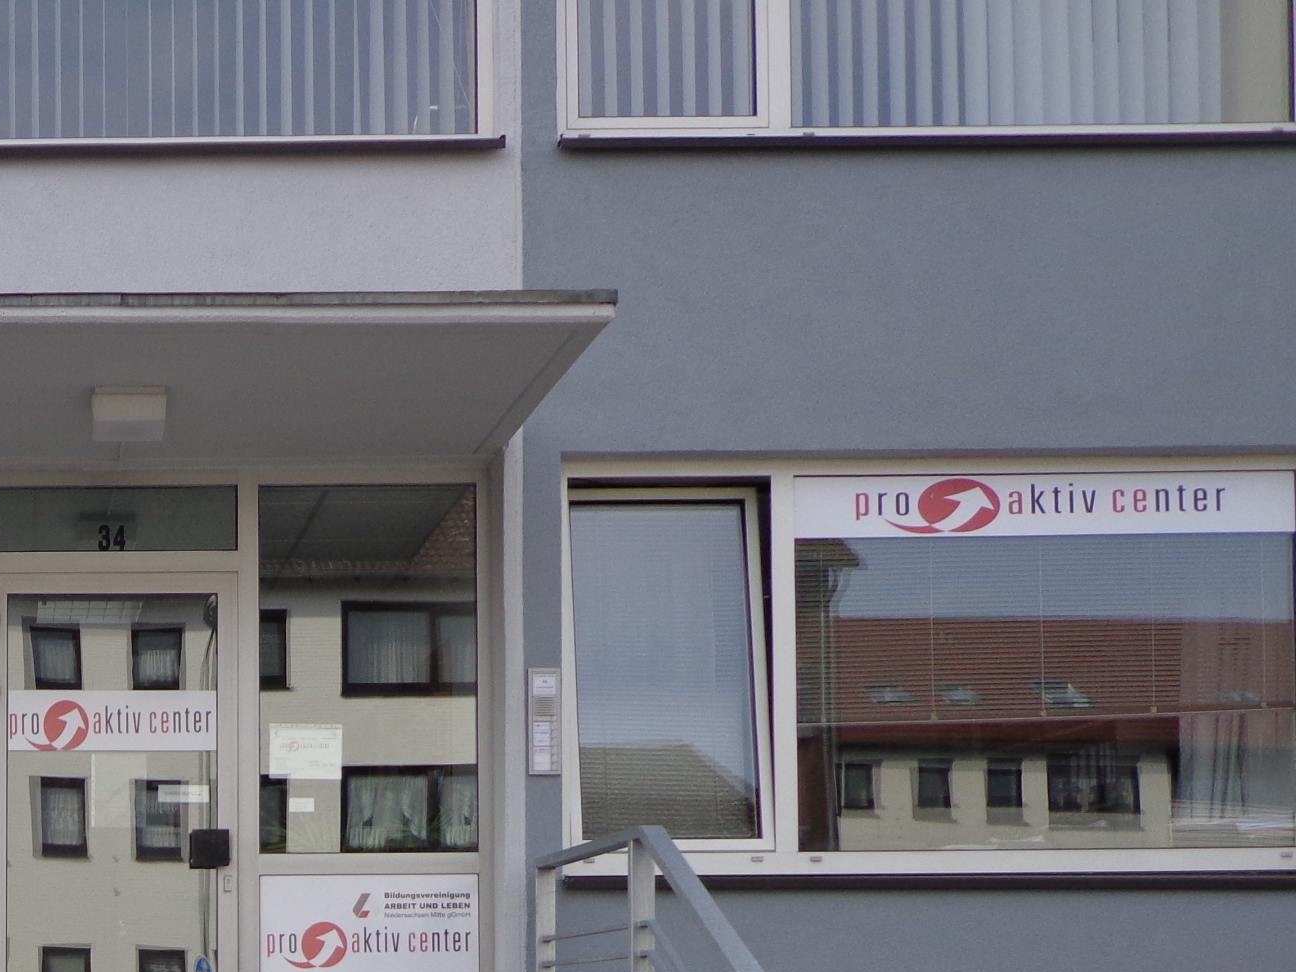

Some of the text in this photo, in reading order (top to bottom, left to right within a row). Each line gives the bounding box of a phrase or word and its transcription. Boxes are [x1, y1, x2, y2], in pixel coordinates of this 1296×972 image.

[855, 483, 1226, 521] pro aktiv center
[98, 524, 126, 550] 34
[9, 705, 212, 740] pro aktiv center
[384, 891, 471, 900] Bildungsvereinigung
[384, 902, 416, 910] ARBEIT
[267, 926, 471, 958] pro aktiv center
